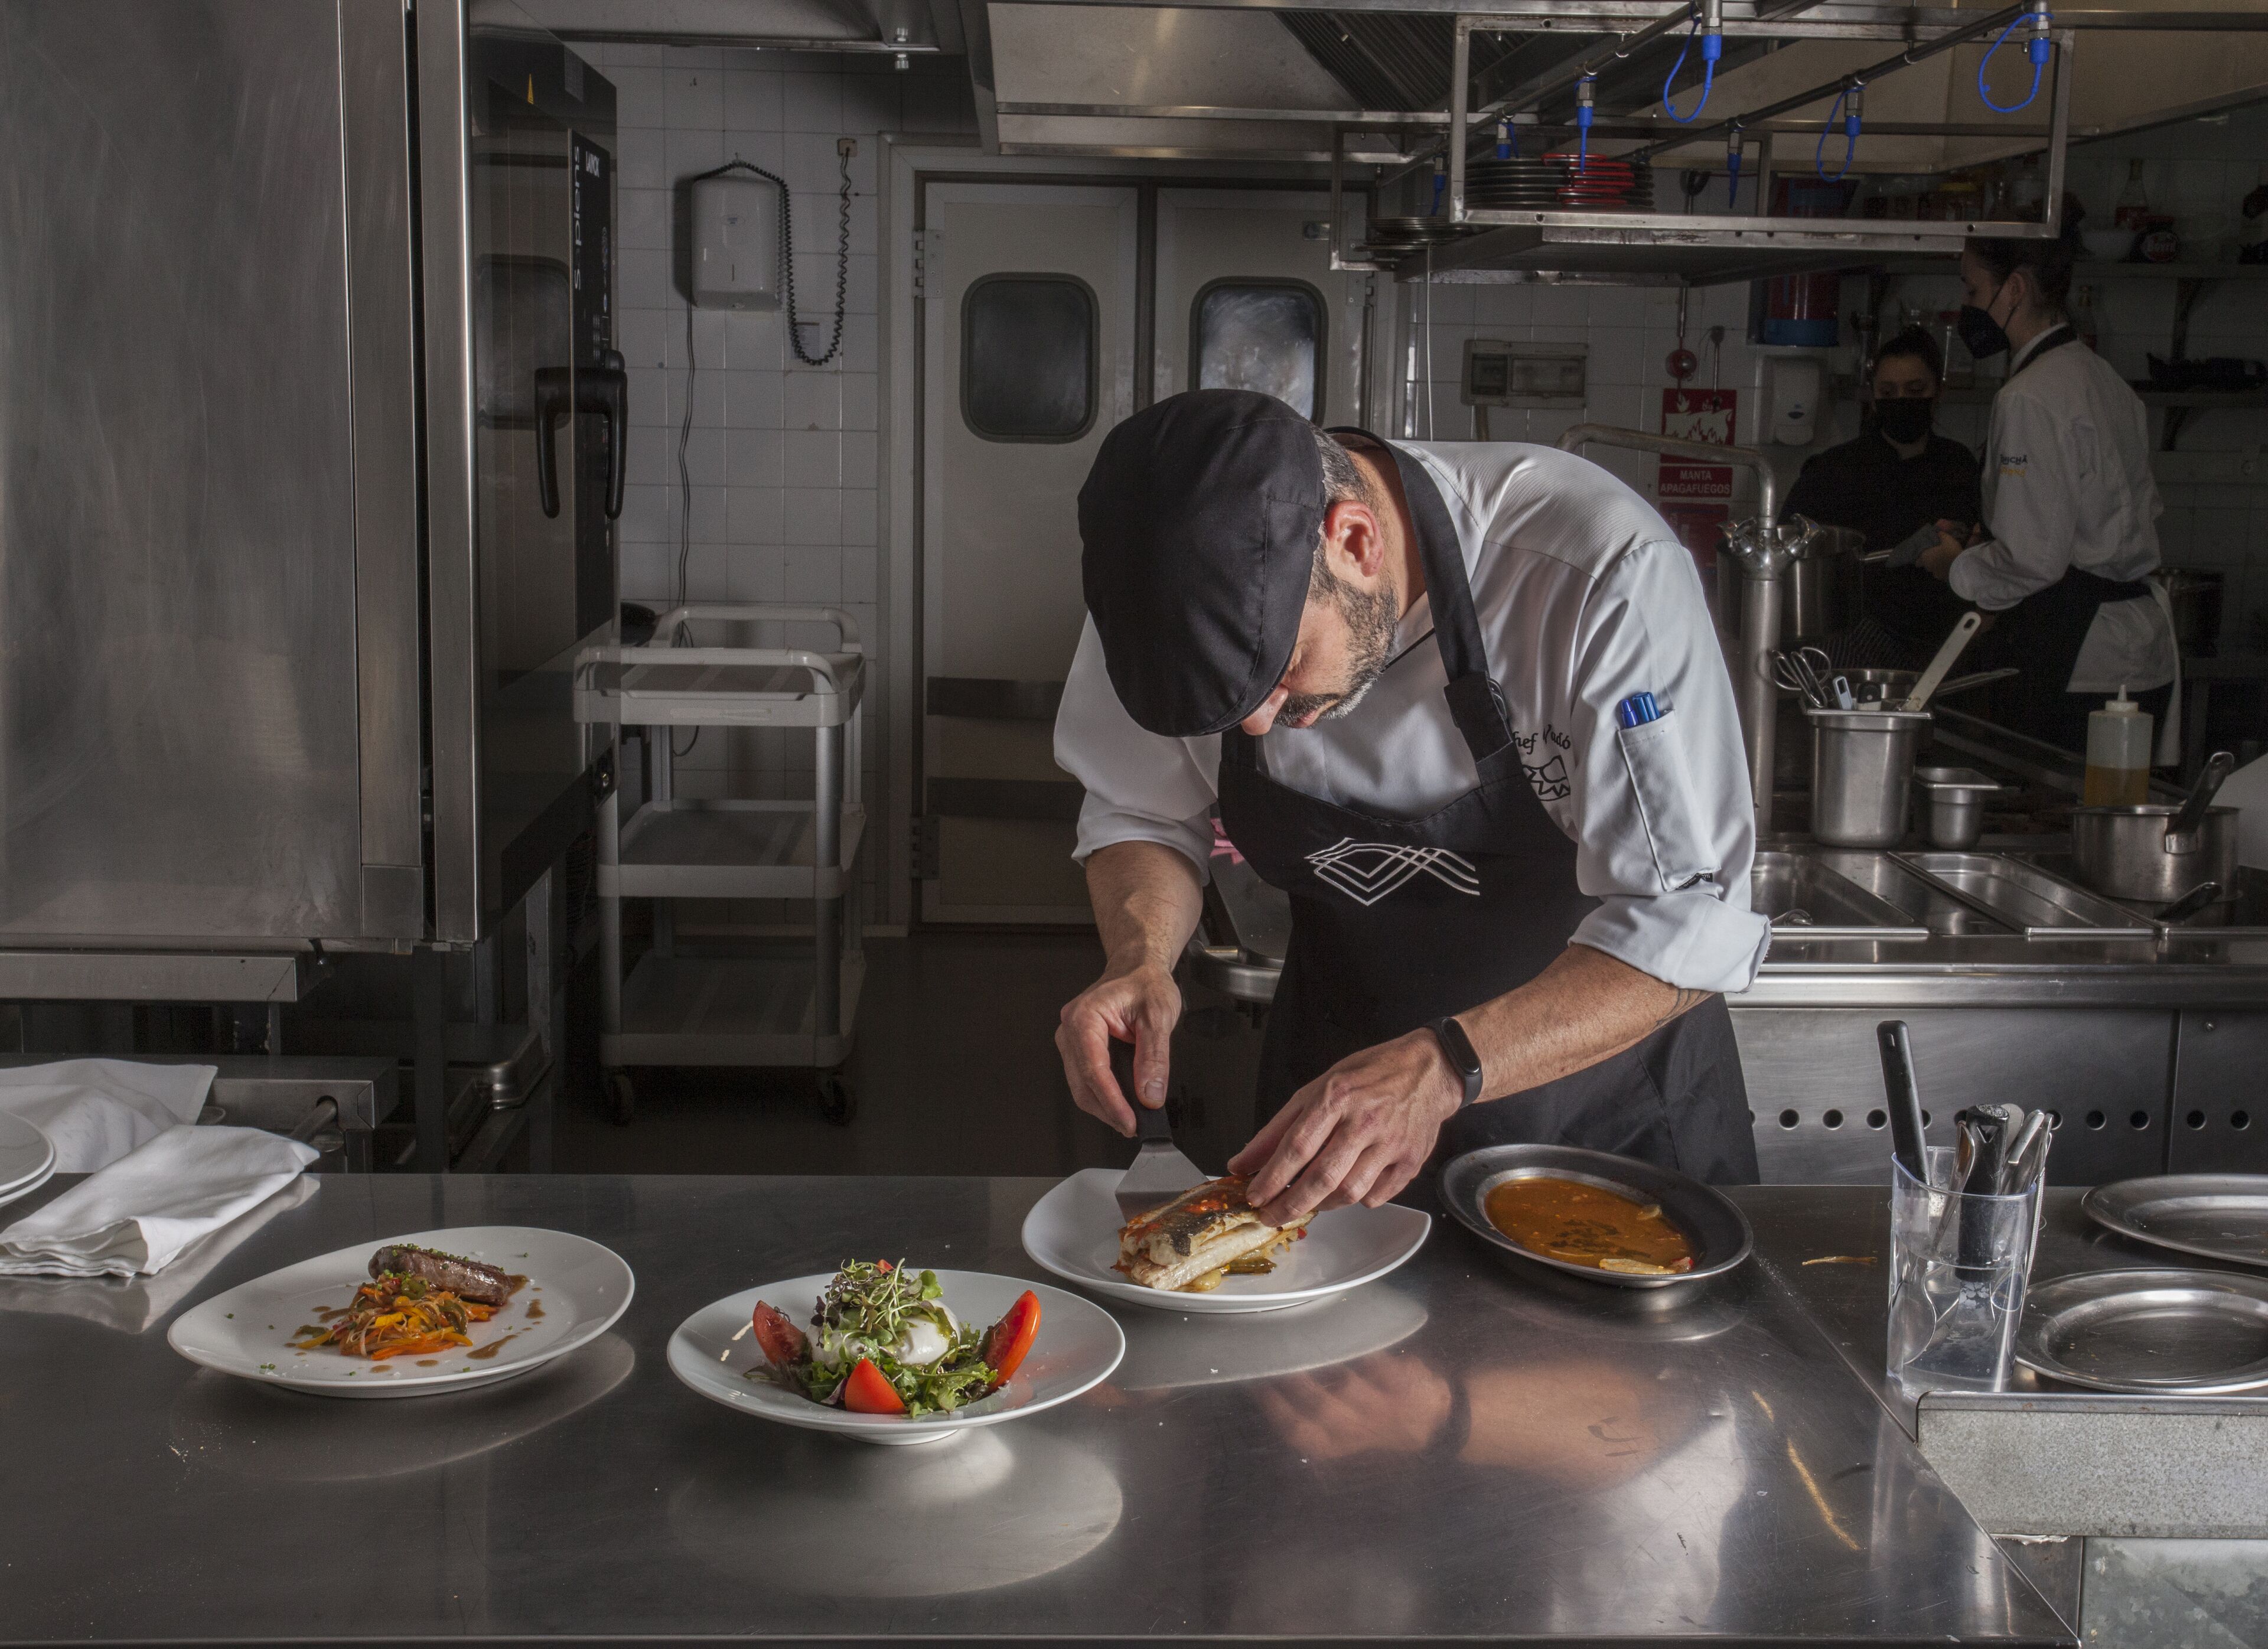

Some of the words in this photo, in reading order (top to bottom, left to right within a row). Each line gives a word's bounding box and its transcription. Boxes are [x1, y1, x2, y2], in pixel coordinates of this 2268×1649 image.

[1680, 471, 1712, 480] MANTA
[1661, 484, 1730, 494] APAGAFUEGOS
[1512, 731, 1539, 755] hef
